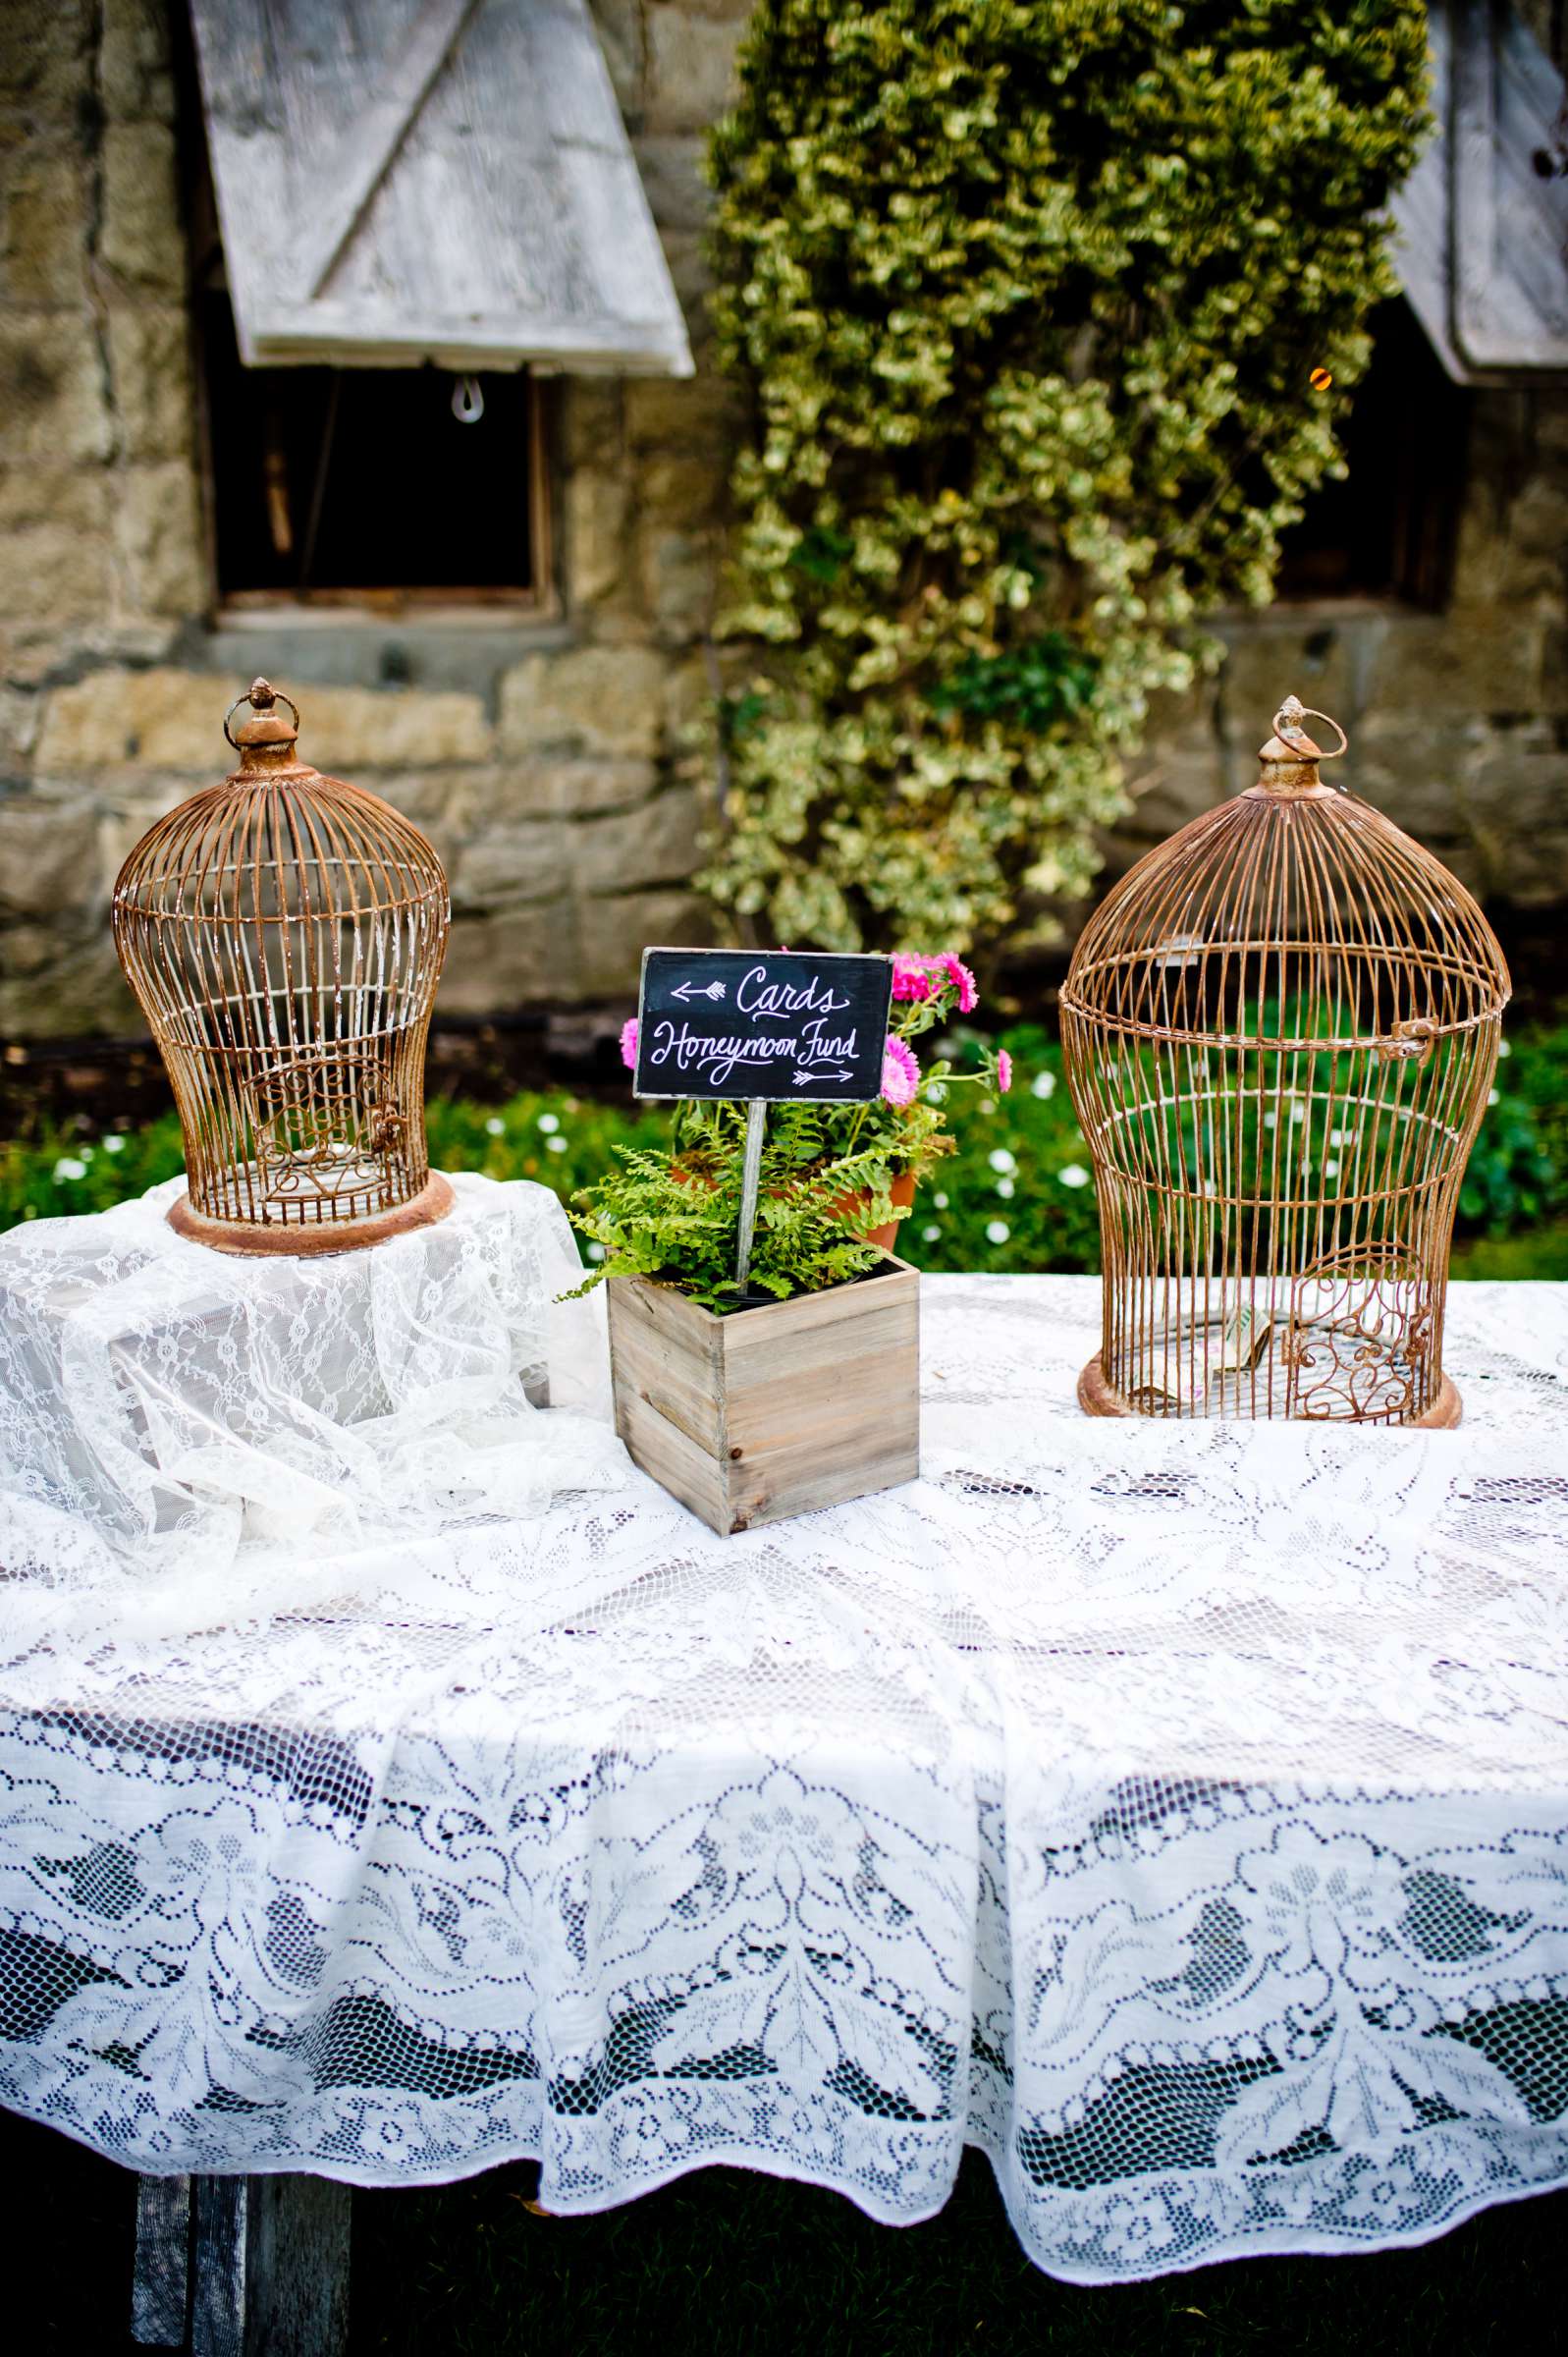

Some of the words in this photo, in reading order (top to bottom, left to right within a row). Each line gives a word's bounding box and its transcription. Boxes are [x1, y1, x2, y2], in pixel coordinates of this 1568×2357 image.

[736, 966, 850, 1014] Cards
[651, 1021, 796, 1085] Honeymoon
[797, 1017, 860, 1066] Fund
